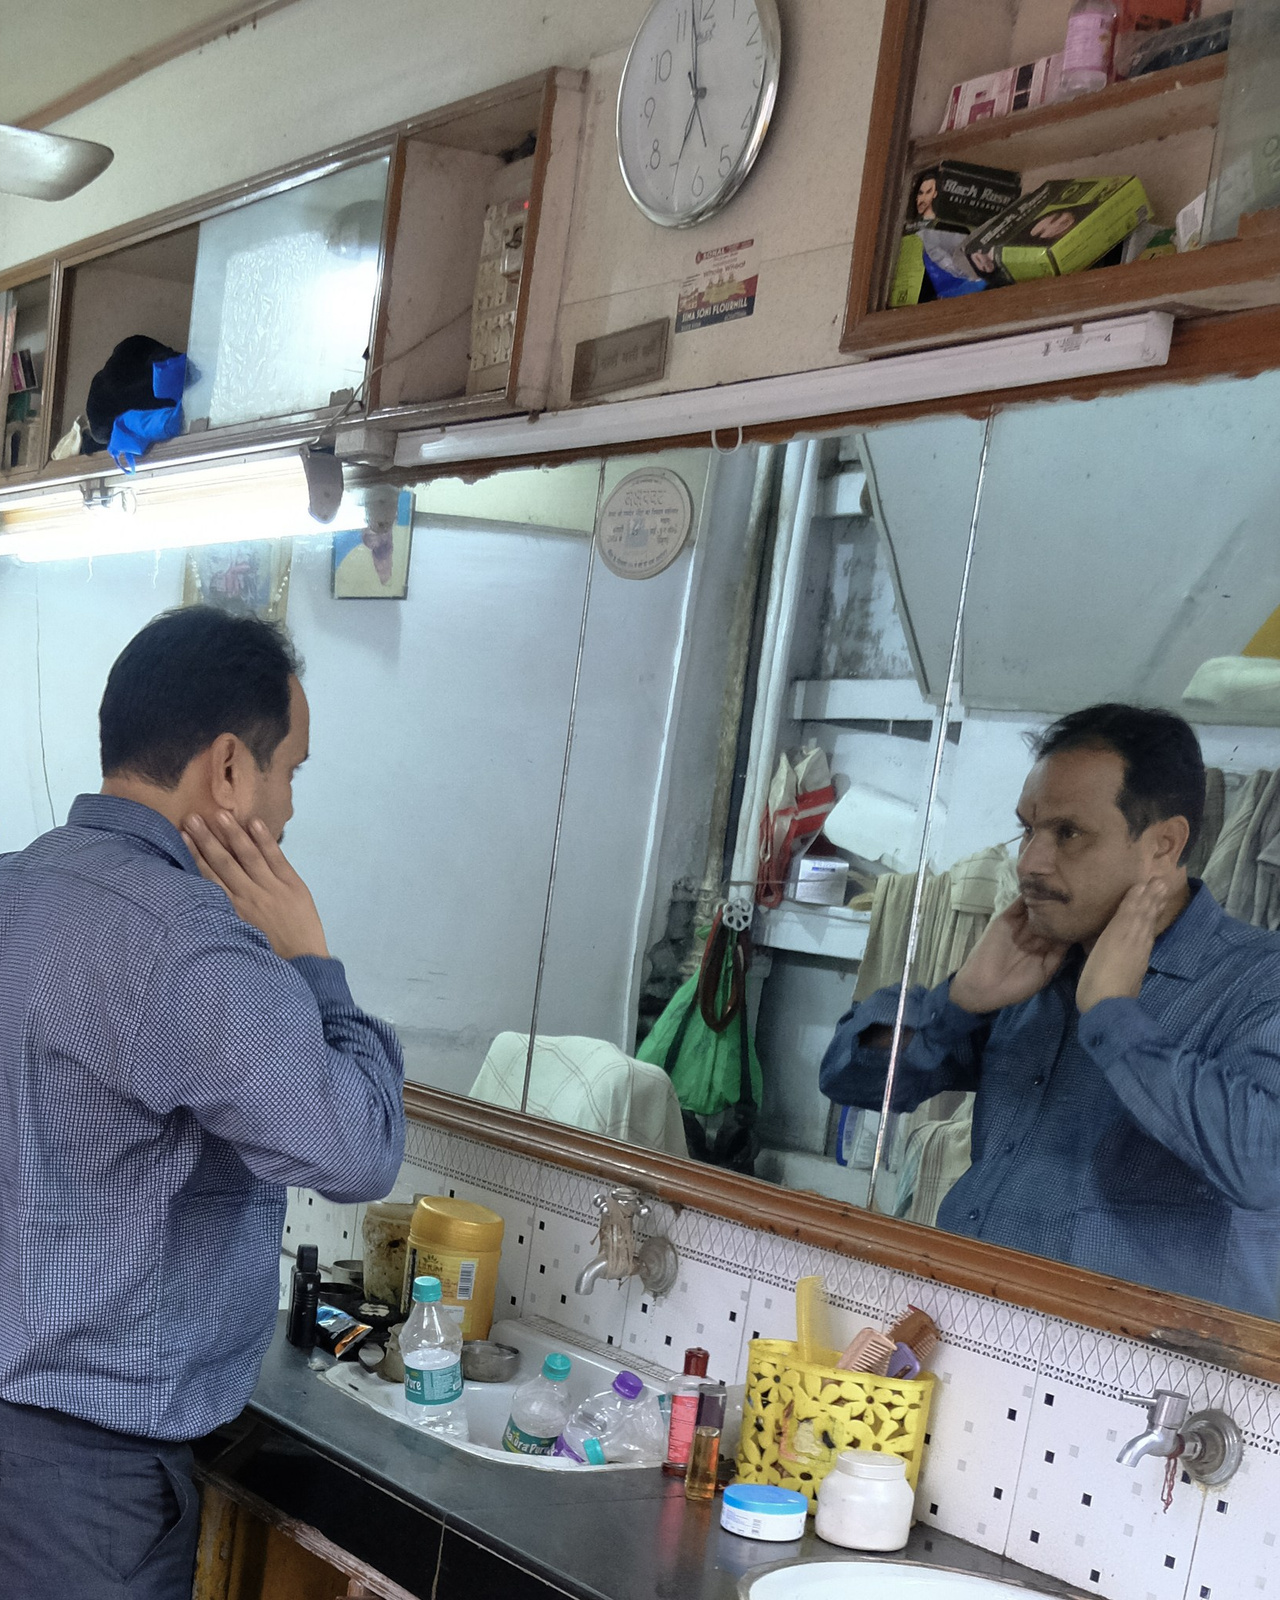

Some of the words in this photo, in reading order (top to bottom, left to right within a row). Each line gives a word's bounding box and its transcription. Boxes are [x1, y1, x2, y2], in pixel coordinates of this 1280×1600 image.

[676, 10, 687, 43] 11
[745, 11, 760, 46] 2
[654, 50, 672, 84] 10
[644, 97, 656, 128] 9
[650, 139, 661, 170] 8
[717, 144, 732, 179] 5
[669, 162, 679, 195] 7
[691, 166, 704, 197] 6
